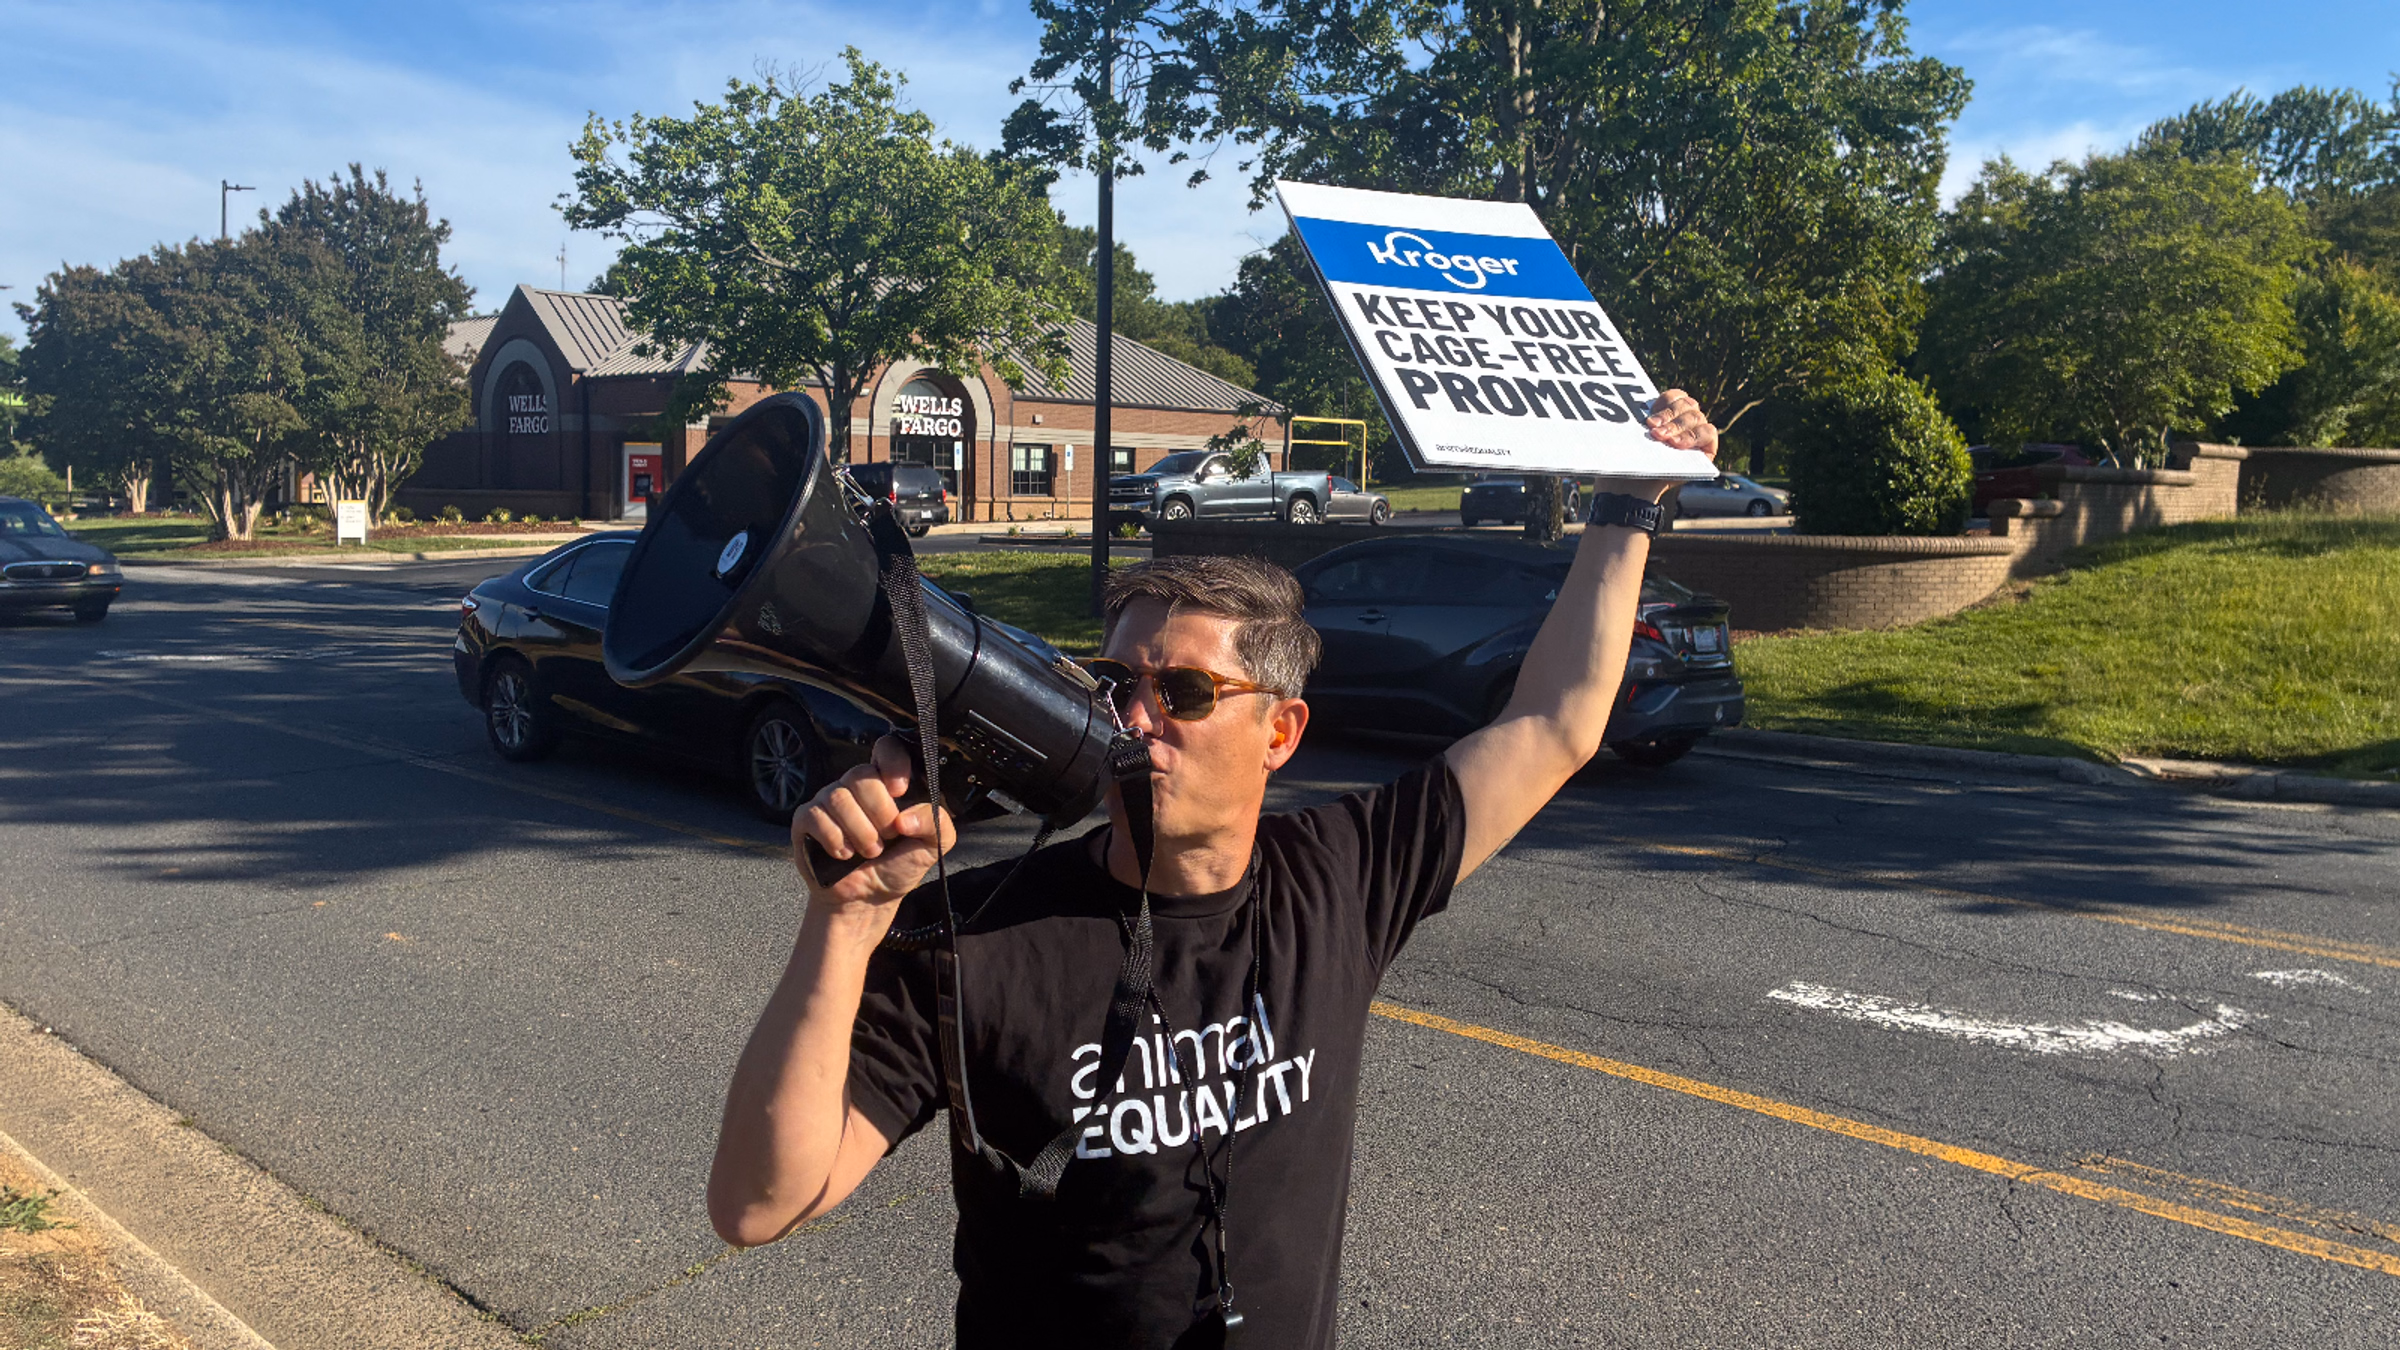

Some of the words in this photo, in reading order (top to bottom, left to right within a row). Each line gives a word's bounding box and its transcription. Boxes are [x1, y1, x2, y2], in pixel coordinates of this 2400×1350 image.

[1366, 231, 1519, 289] Kroger
[1352, 292, 1475, 332] KEEP
[1477, 303, 1613, 341] YOUR
[1374, 330, 1637, 379] CAGE-FREE
[899, 394, 963, 417] WELLS
[1394, 367, 1651, 430] PROMISE
[509, 416, 549, 434] FARGO
[900, 416, 962, 437] FARGO
[1071, 993, 1275, 1099] animal
[1072, 1048, 1316, 1160] EQUALITY
